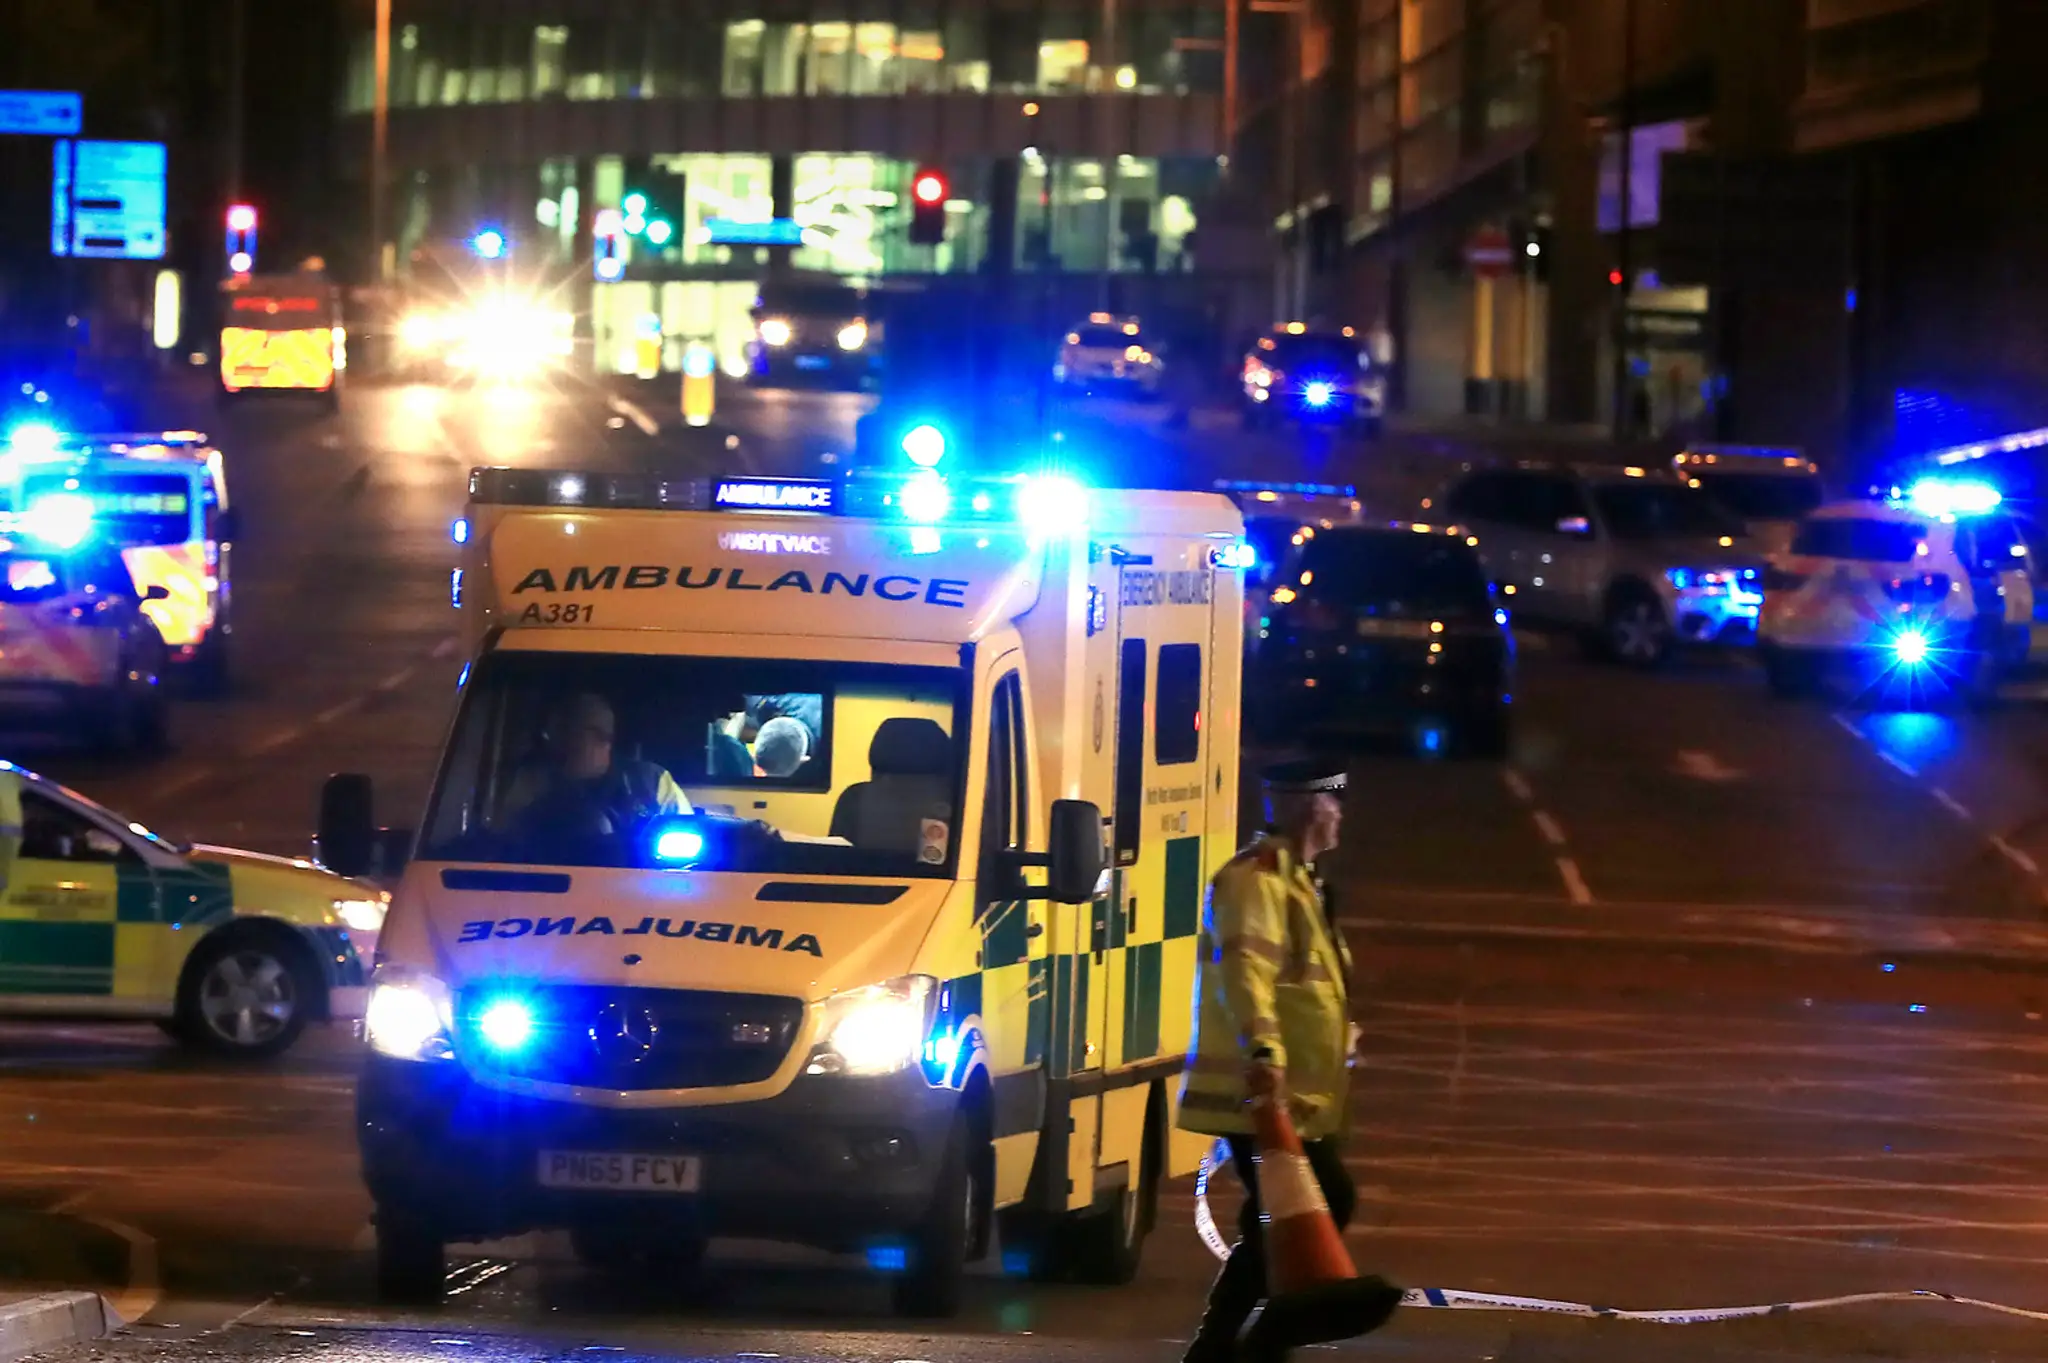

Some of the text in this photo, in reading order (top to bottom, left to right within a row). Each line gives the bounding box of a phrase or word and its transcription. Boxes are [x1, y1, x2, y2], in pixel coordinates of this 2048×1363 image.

[716, 484, 831, 507] AMBULANCE
[511, 566, 969, 608] AMBULANCE
[518, 603, 594, 624] A381
[551, 1154, 687, 1187] PN65 FCV
